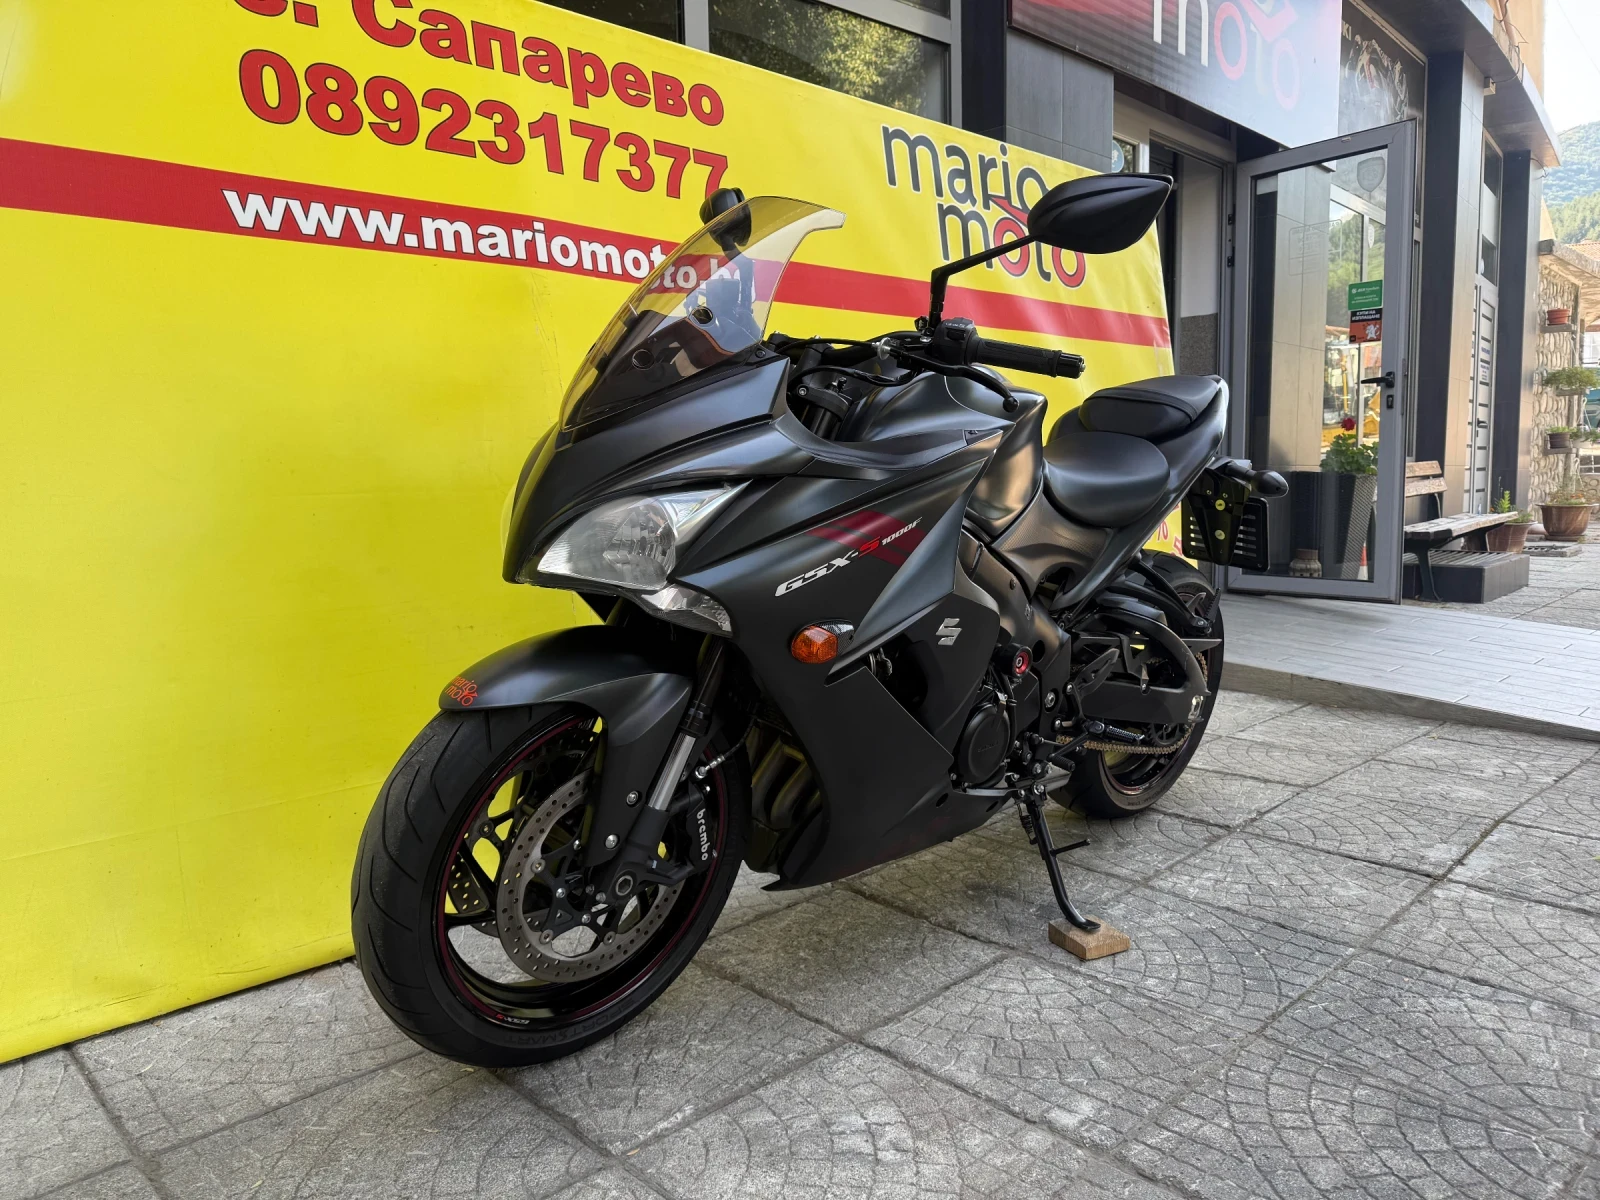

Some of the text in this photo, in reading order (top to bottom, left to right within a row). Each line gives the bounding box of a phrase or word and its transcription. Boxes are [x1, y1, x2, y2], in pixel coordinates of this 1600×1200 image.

[352, 0, 725, 127] Сапарево
[238, 49, 729, 200] 0892317377
[881, 124, 1049, 211] mario
[696, 808, 711, 861] brembo
